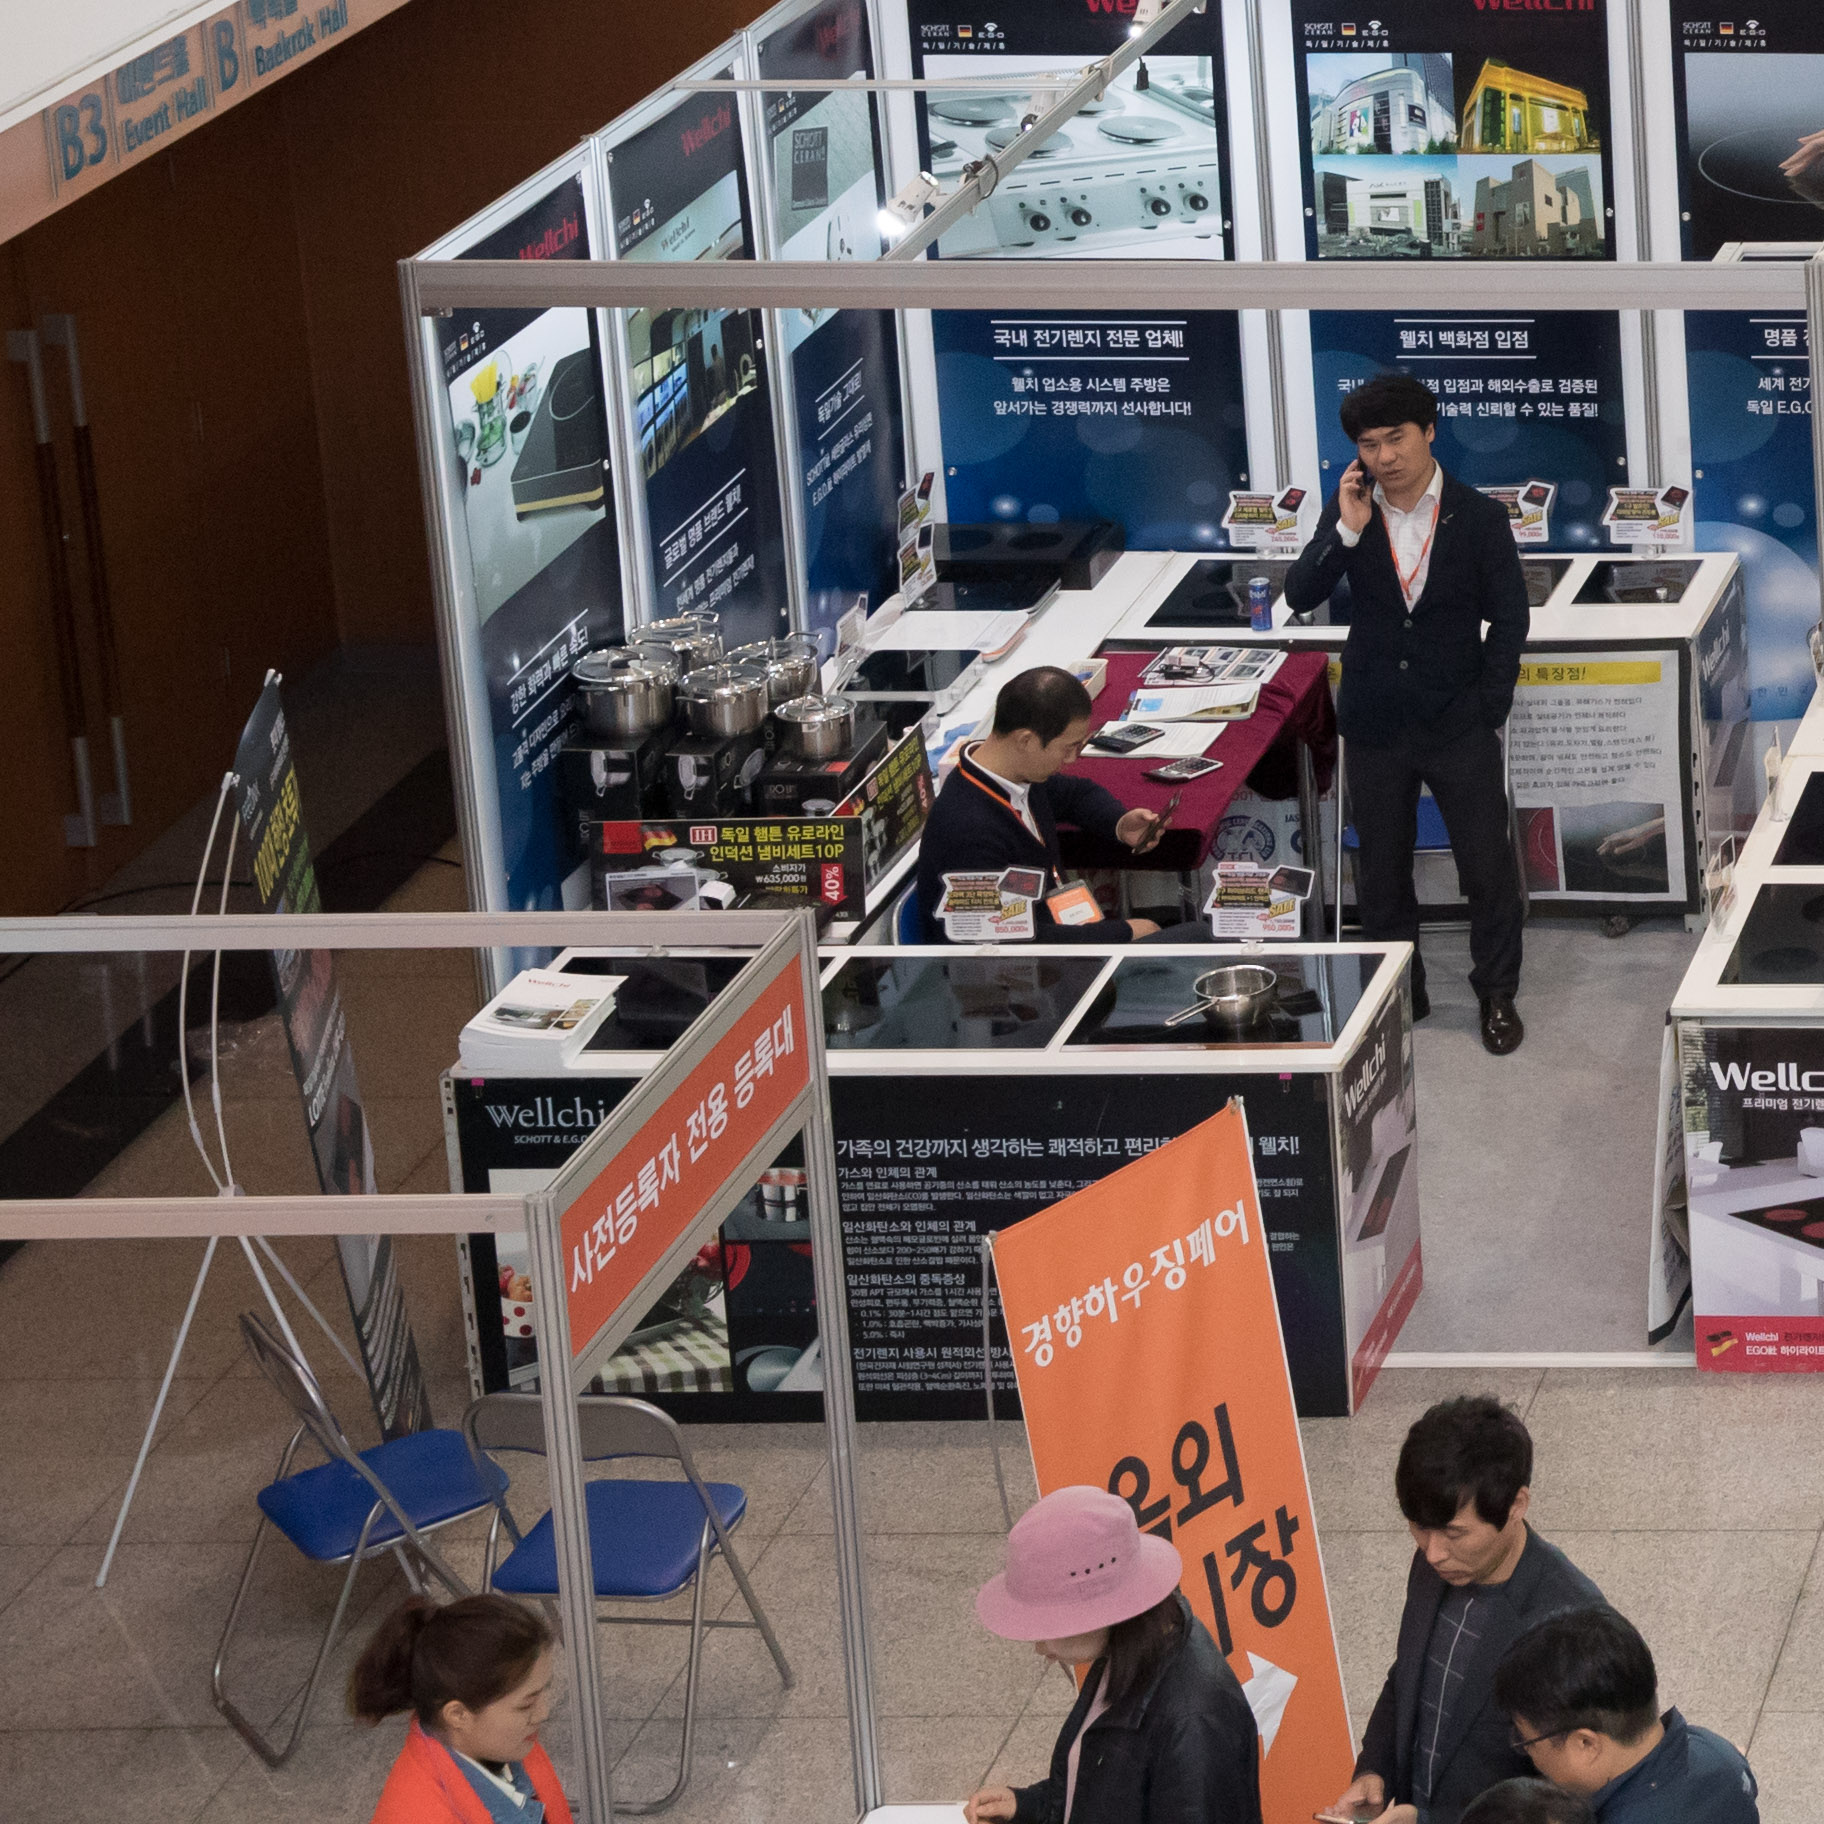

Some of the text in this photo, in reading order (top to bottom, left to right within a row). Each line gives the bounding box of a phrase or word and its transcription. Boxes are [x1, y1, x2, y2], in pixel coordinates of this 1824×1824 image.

[55, 92, 108, 181] B3
[123, 100, 172, 154] Event
[174, 76, 208, 123] Hall
[213, 19, 240, 93] B
[254, 16, 316, 77] Baekrok
[680, 101, 732, 157] Wellchi
[993, 329, 1184, 348] 국내 전기렌지 전문 업체!
[1400, 330, 1530, 349] 웰치 백화점 입점
[1763, 328, 1798, 348] 명품
[1012, 377, 1171, 393] 웰치 업소용 시스템 주방은
[1443, 379, 1484, 394] 입점과
[1488, 379, 1555, 394] 해외수출로
[1559, 379, 1598, 394] 검증된
[1758, 376, 1786, 392] 세계
[993, 400, 1192, 416] 앞서가는 경쟁력까지 선사합니다!
[1476, 402, 1599, 417] 신뢰할 수 있는 품질!
[1747, 400, 1773, 415] 독일
[703, 499, 726, 534] 브랜드
[1535, 666, 1587, 682] 특장점!
[510, 684, 528, 716] 강한
[527, 659, 553, 700] 화력과
[692, 824, 845, 843] IH 독일 햄튼 유로라인
[709, 843, 845, 863] 인덕션 냄비세트10P
[772, 862, 807, 874] 소비자가
[824, 865, 841, 901] 40%
[1001, 899, 1027, 920] SALE
[1267, 898, 1296, 919] SALE
[1343, 1032, 1387, 1119] Wellchi
[485, 1096, 605, 1129] Wellchi
[1742, 1098, 1789, 1111] 프리미엄
[513, 1133, 561, 1145] SCHOTT &
[567, 1002, 795, 1295] 사전등록자 전용 등록대
[837, 1136, 1300, 1159] 가족의 건강까지 생각하는 쾌적하고 웰치!
[838, 1166, 938, 1179] 가스와 인체의 관계
[842, 1221, 977, 1234] 일산화탄소와 인체의 관계
[846, 1274, 917, 1286] 일산화탄소의
[1020, 1198, 1251, 1368] 경향하우징페어
[1745, 1331, 1780, 1342] Wellchi
[853, 1347, 900, 1360] 전기렌지
[903, 1347, 938, 1360] 사용시
